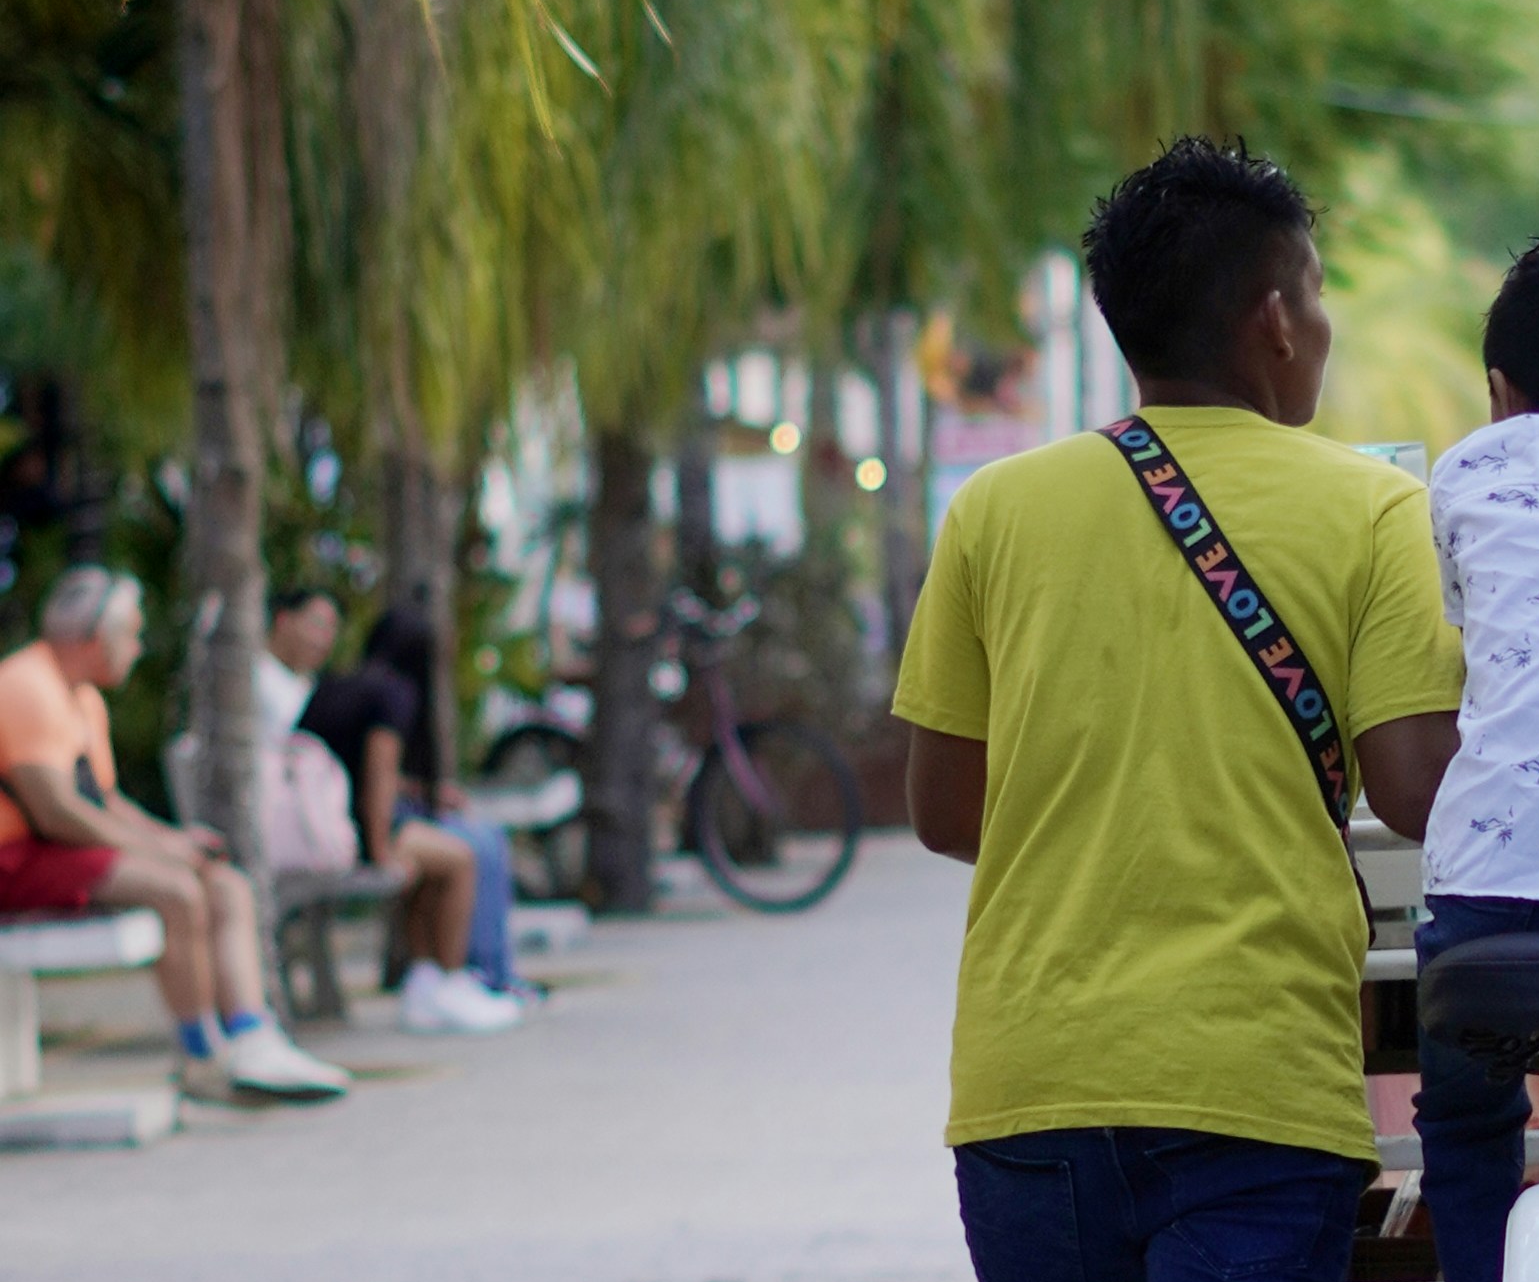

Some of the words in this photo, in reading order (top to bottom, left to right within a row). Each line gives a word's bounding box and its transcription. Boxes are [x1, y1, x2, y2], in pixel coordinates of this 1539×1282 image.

[1103, 419, 1162, 462] LOV
[1143, 462, 1212, 548] LOVE
[1195, 542, 1274, 639] LOVE
[1259, 636, 1333, 741] LOVE
[1319, 744, 1348, 819] OVE
